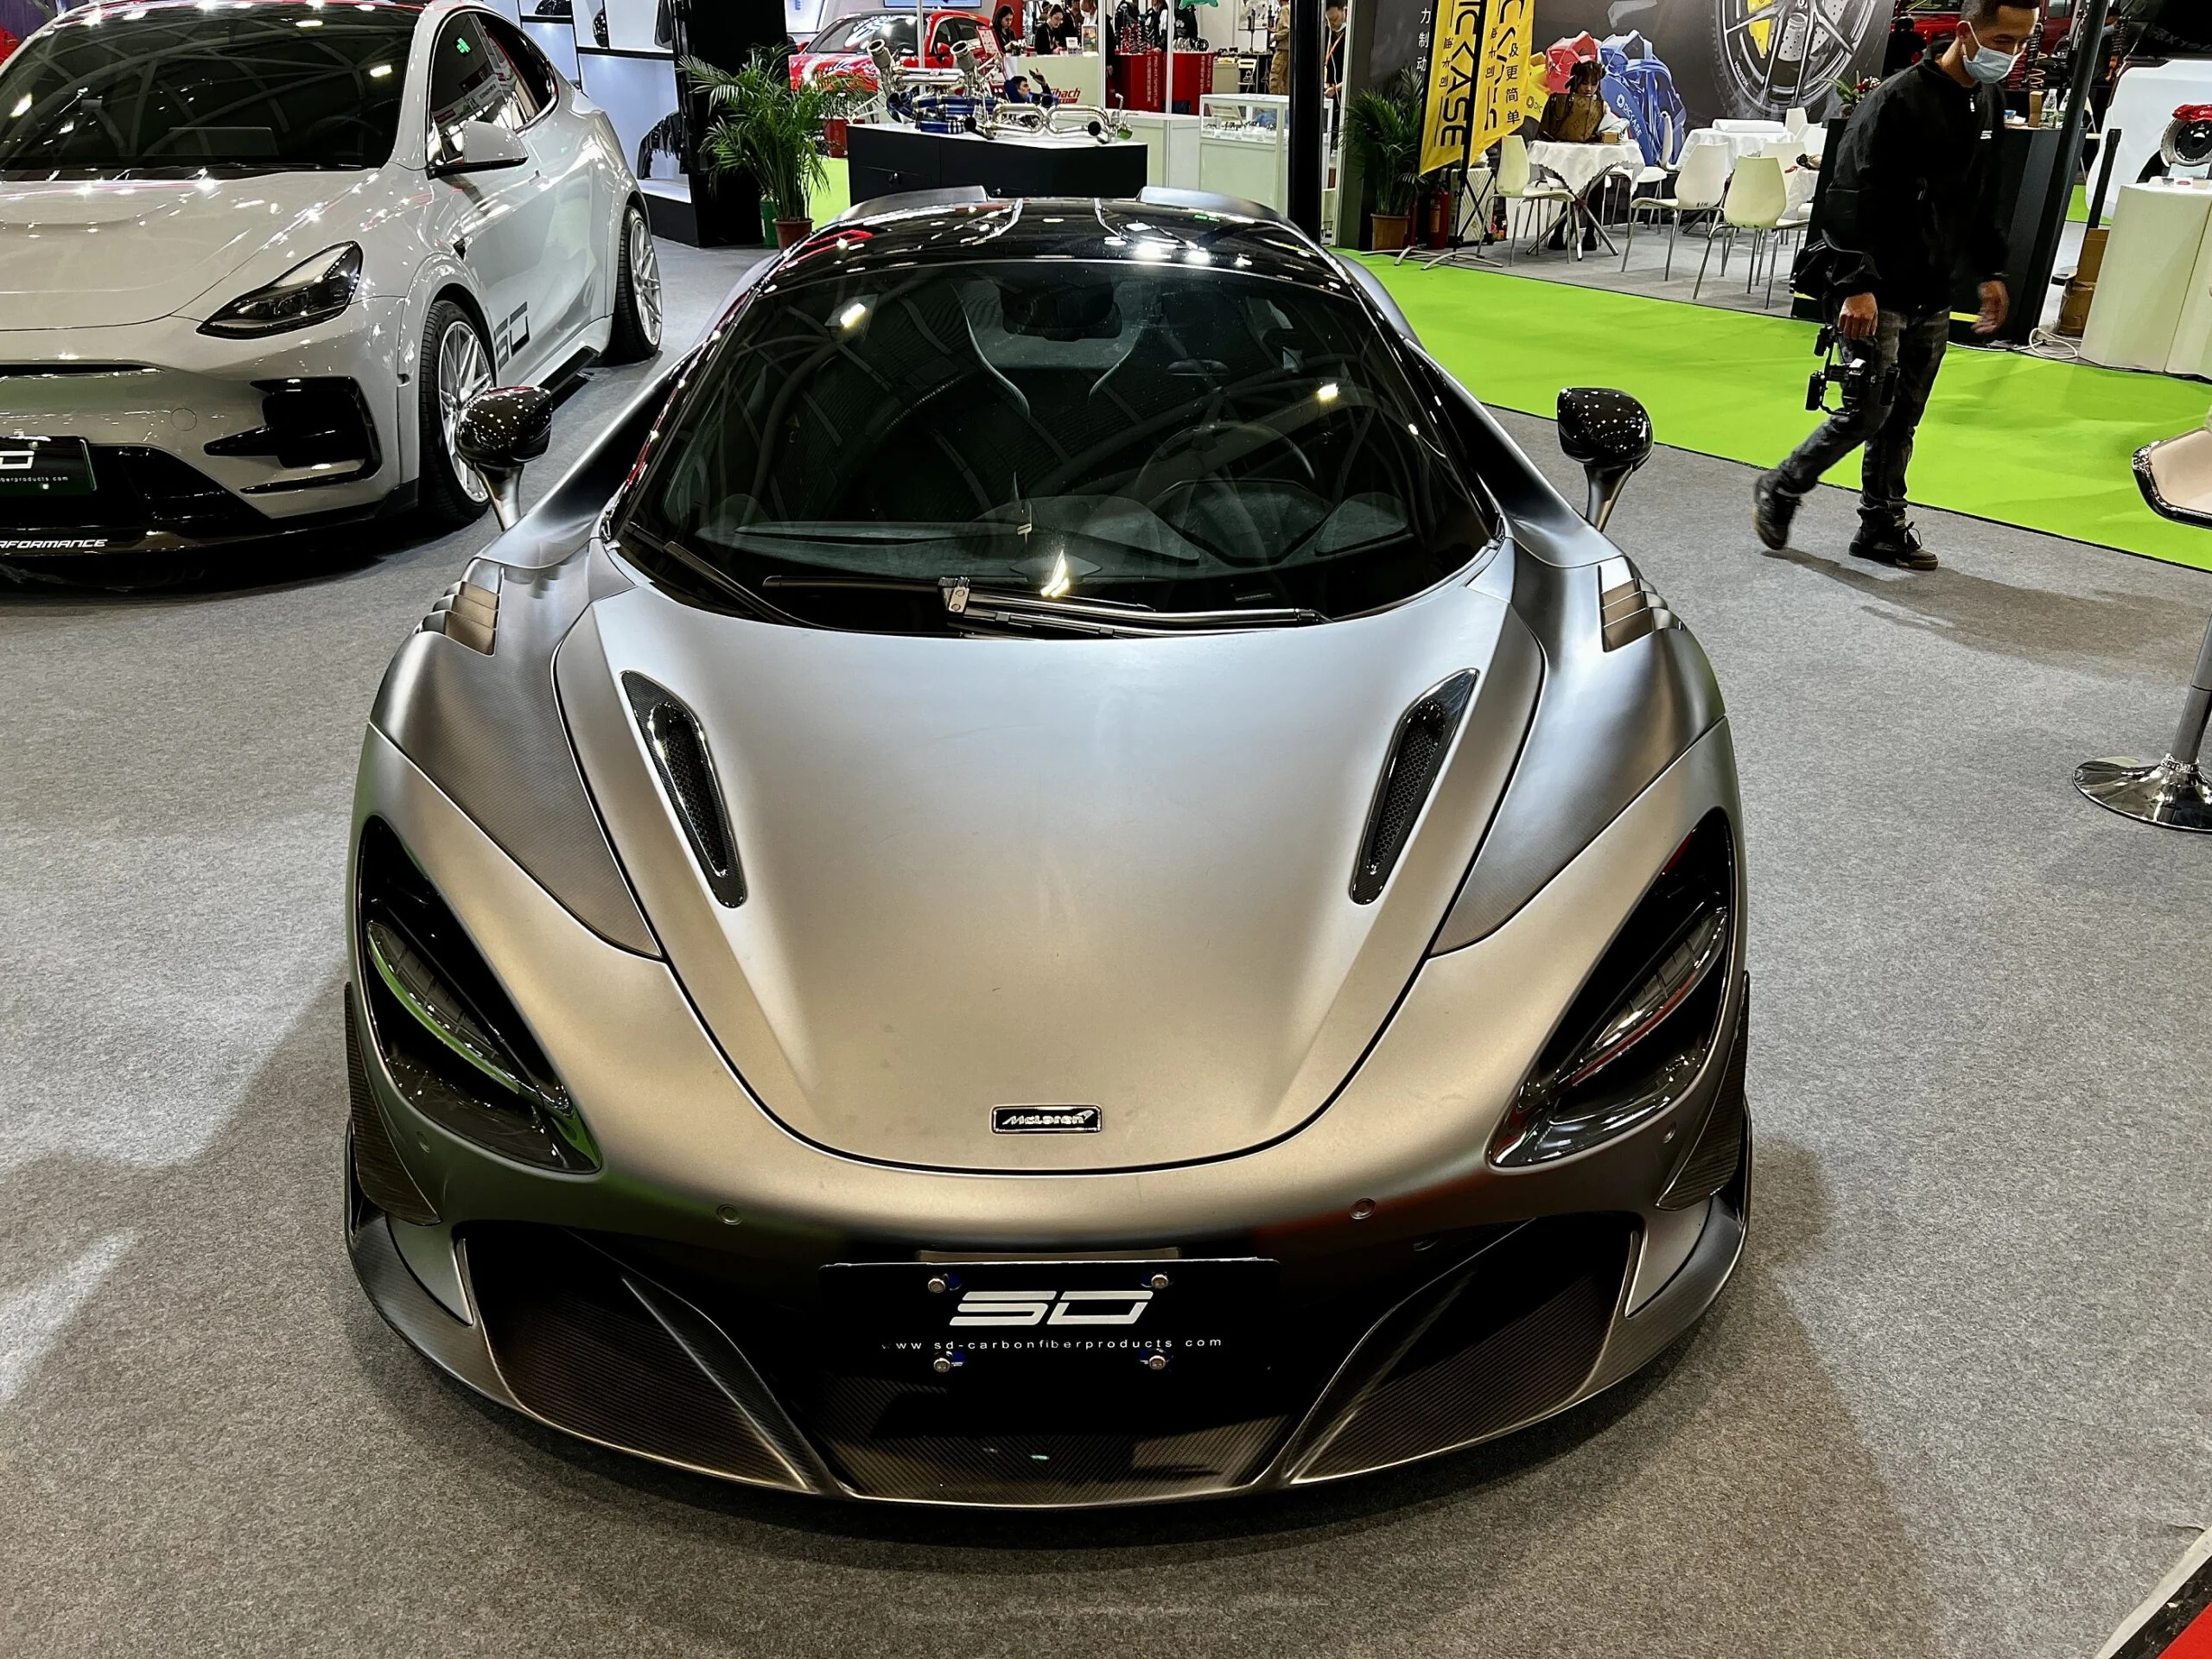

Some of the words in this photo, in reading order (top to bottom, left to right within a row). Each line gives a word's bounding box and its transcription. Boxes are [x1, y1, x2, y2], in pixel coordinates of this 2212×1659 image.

[1415, 8, 1432, 72] 力制动
[1052, 87, 1081, 99] ibach
[1001, 1115, 1085, 1125] McLaren
[950, 1290, 1154, 1326] SD
